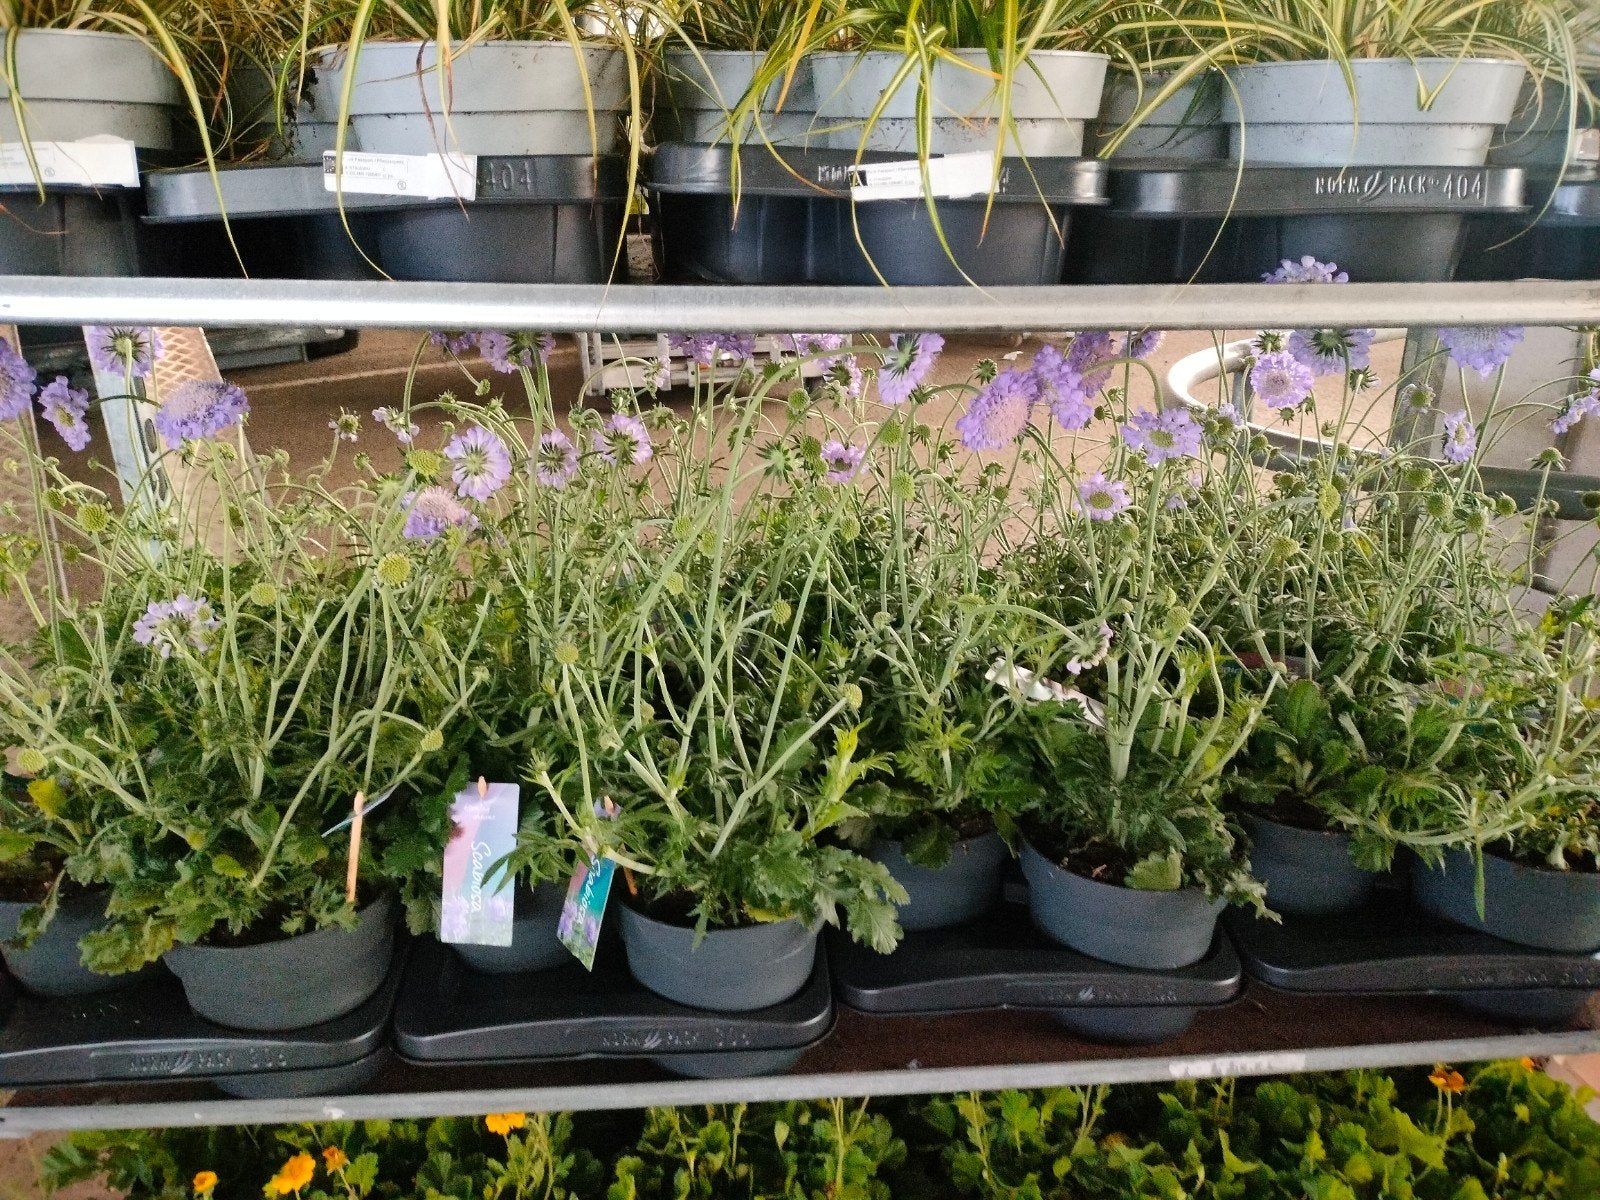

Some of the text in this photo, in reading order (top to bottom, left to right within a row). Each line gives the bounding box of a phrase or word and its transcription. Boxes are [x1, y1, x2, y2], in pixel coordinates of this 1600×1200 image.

[1315, 173, 1481, 200] NORM PACK 404
[470, 841, 491, 912] Scabiosa
